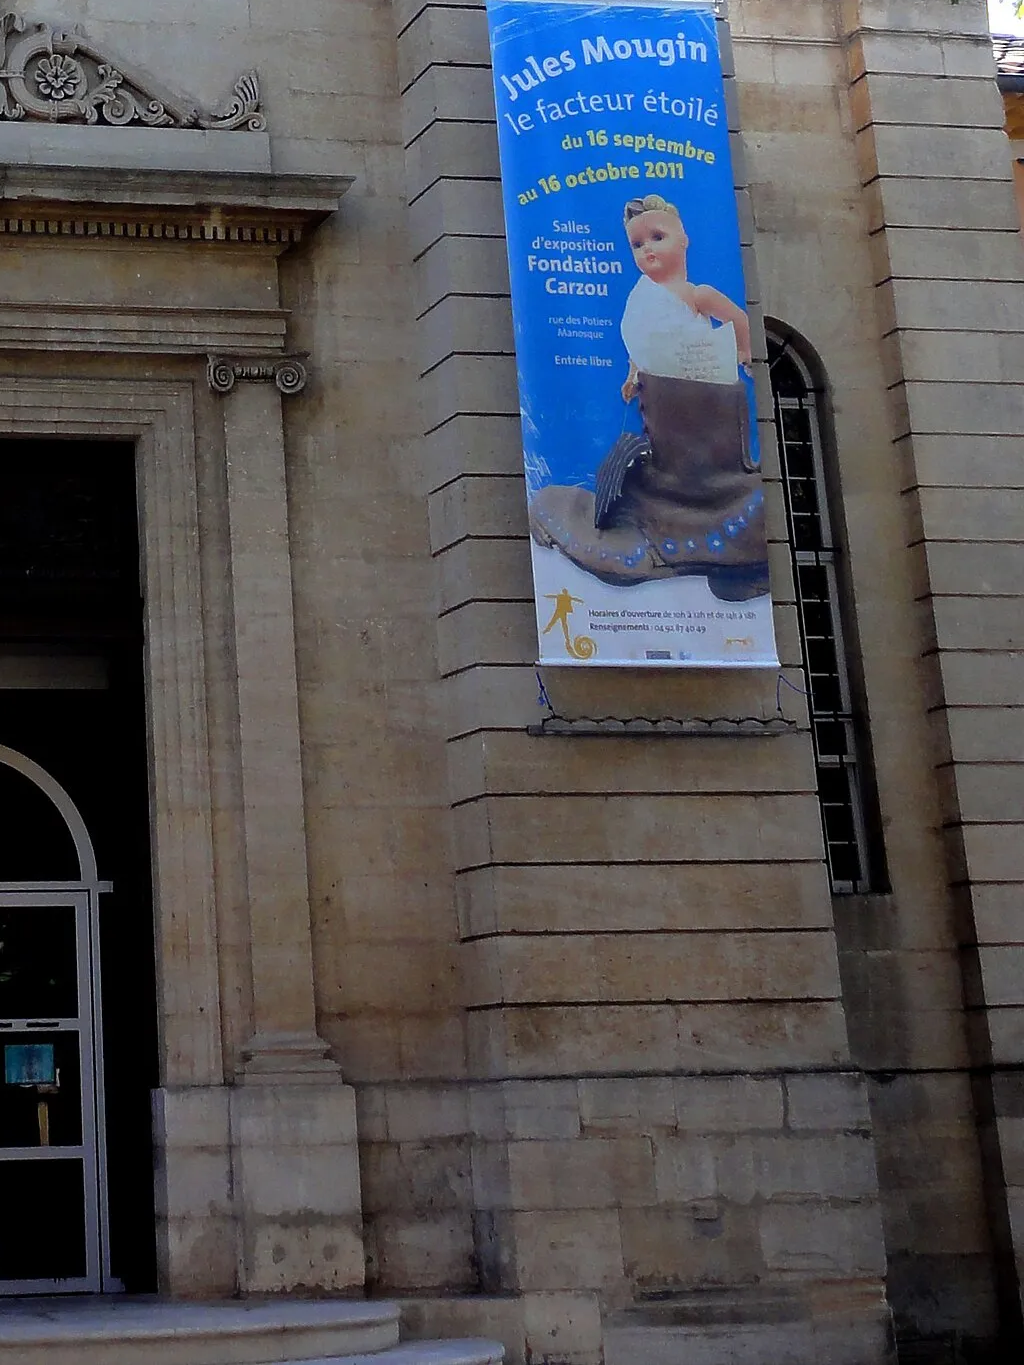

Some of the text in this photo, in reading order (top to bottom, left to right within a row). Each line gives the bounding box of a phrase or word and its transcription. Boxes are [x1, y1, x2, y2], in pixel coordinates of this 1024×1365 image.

[501, 32, 707, 101] Jules Mougin
[504, 89, 719, 135] le facteur étoilé
[561, 130, 716, 165] du 16 septembre
[517, 162, 684, 206] au 16 octobre 2011
[553, 220, 591, 234] Salles
[532, 236, 615, 254] d'exposition
[527, 255, 623, 274] Fondation
[545, 277, 608, 296] Carzou
[566, 314, 581, 325] des
[582, 316, 613, 326] Potiers
[557, 328, 604, 340] Manosque
[555, 355, 613, 367] Entrée libre
